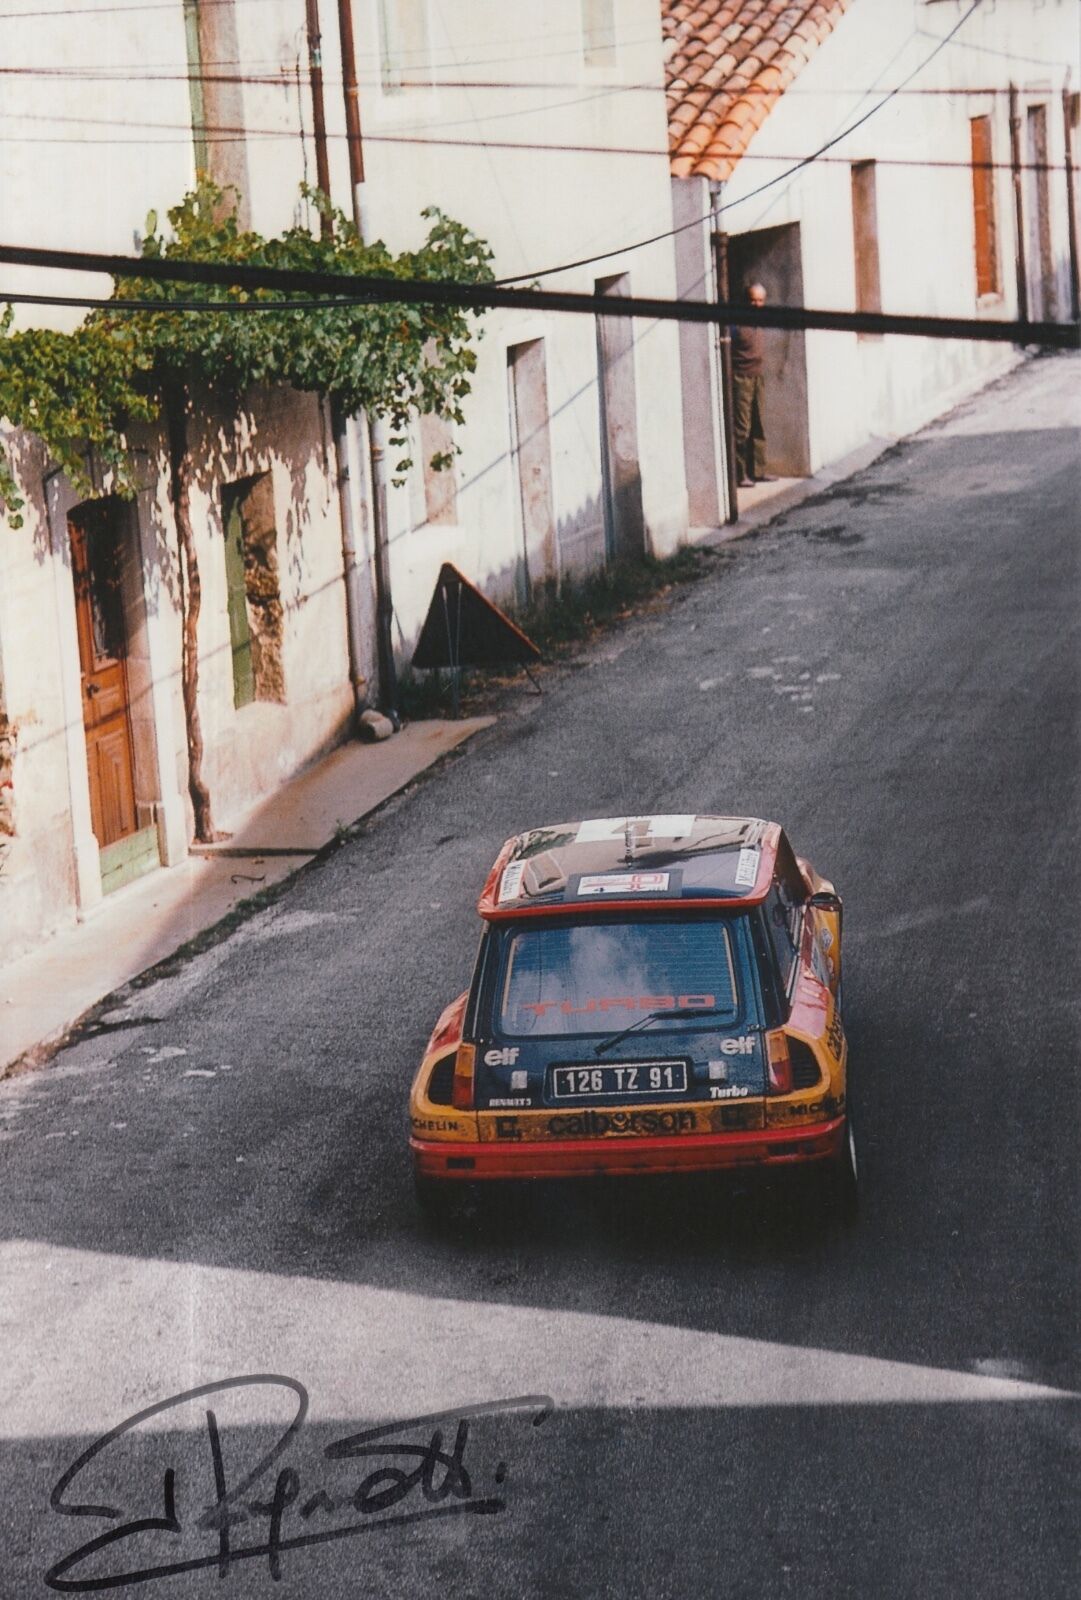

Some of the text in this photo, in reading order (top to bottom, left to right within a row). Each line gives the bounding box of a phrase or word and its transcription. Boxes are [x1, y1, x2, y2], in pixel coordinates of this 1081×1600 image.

[522, 995, 715, 1016] TURBO
[720, 1036, 755, 1055] elf
[484, 1047, 520, 1066] elf
[566, 1067, 673, 1093] 126 TZ 91
[709, 1085, 748, 1098] Turbo
